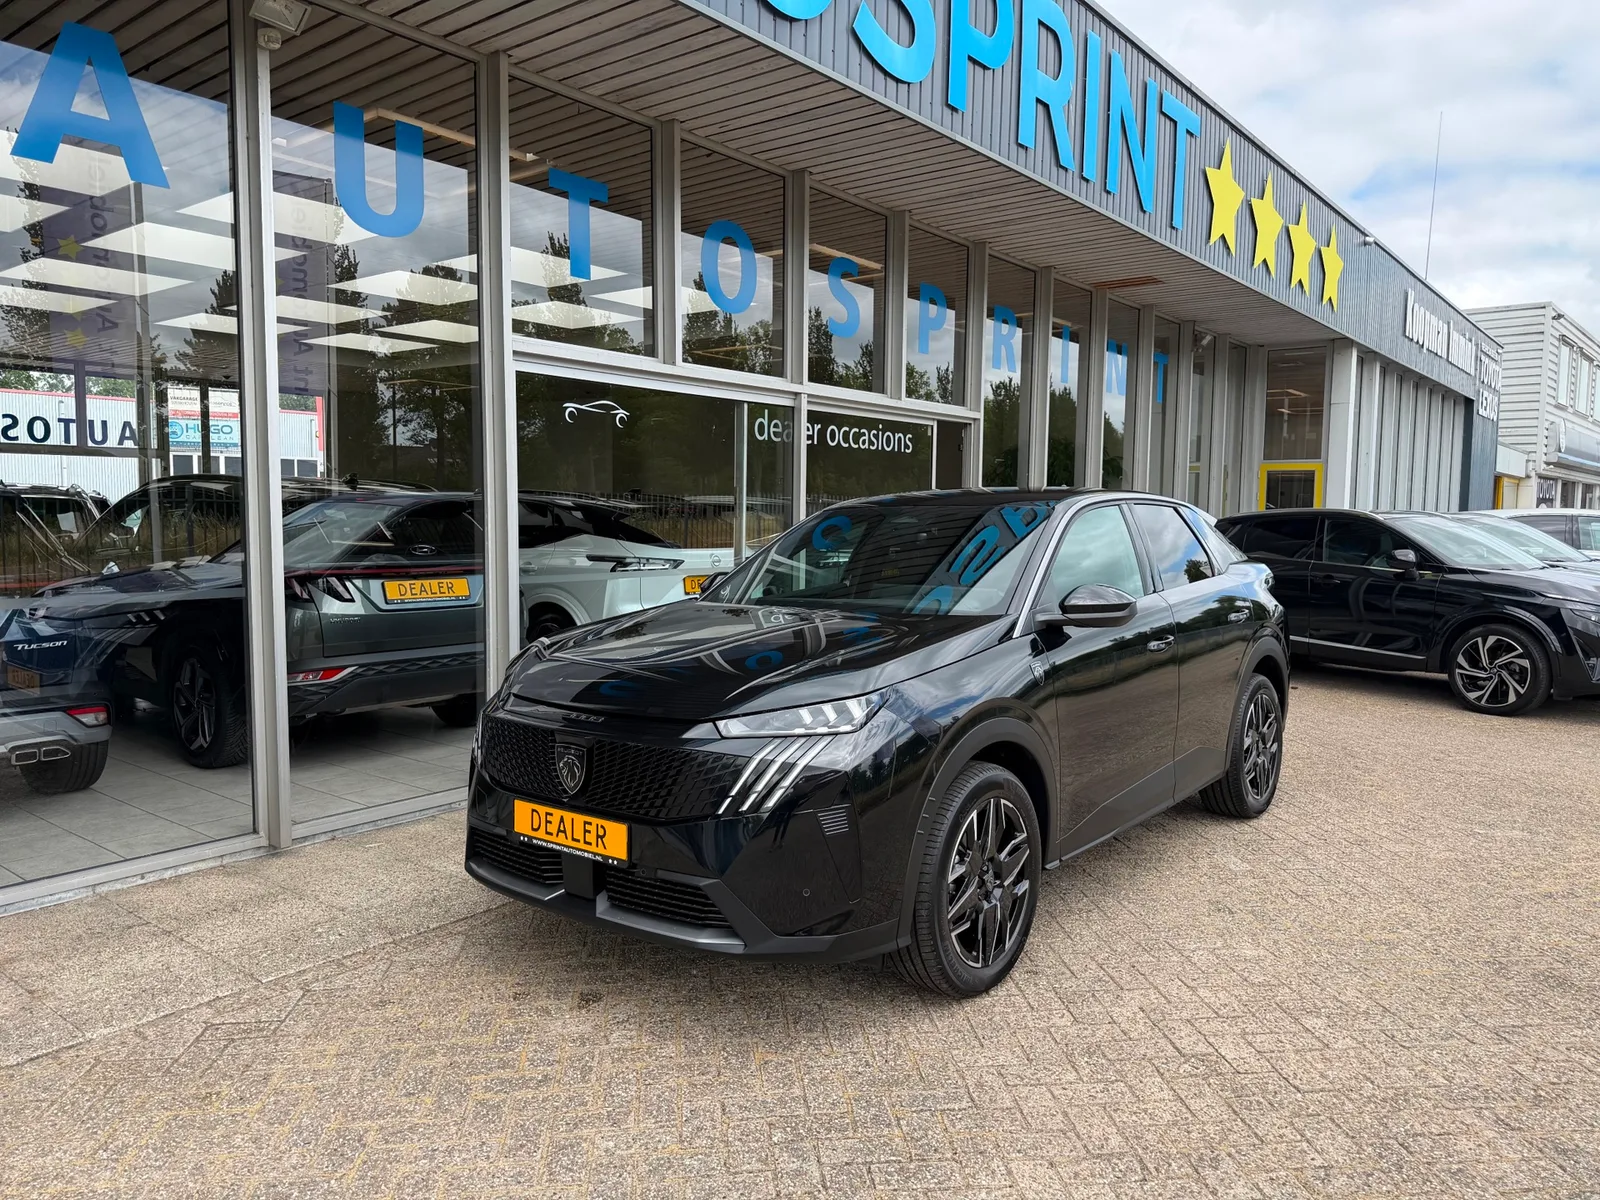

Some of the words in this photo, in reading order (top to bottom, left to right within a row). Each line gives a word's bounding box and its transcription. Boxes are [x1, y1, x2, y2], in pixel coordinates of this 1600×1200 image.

[1478, 387, 1499, 421] LEXUS
[754, 408, 821, 446] deaer
[826, 423, 914, 454] occasions
[397, 581, 456, 597] DEALER
[557, 747, 583, 756] PEUGEOT
[530, 807, 607, 850] DEALER
